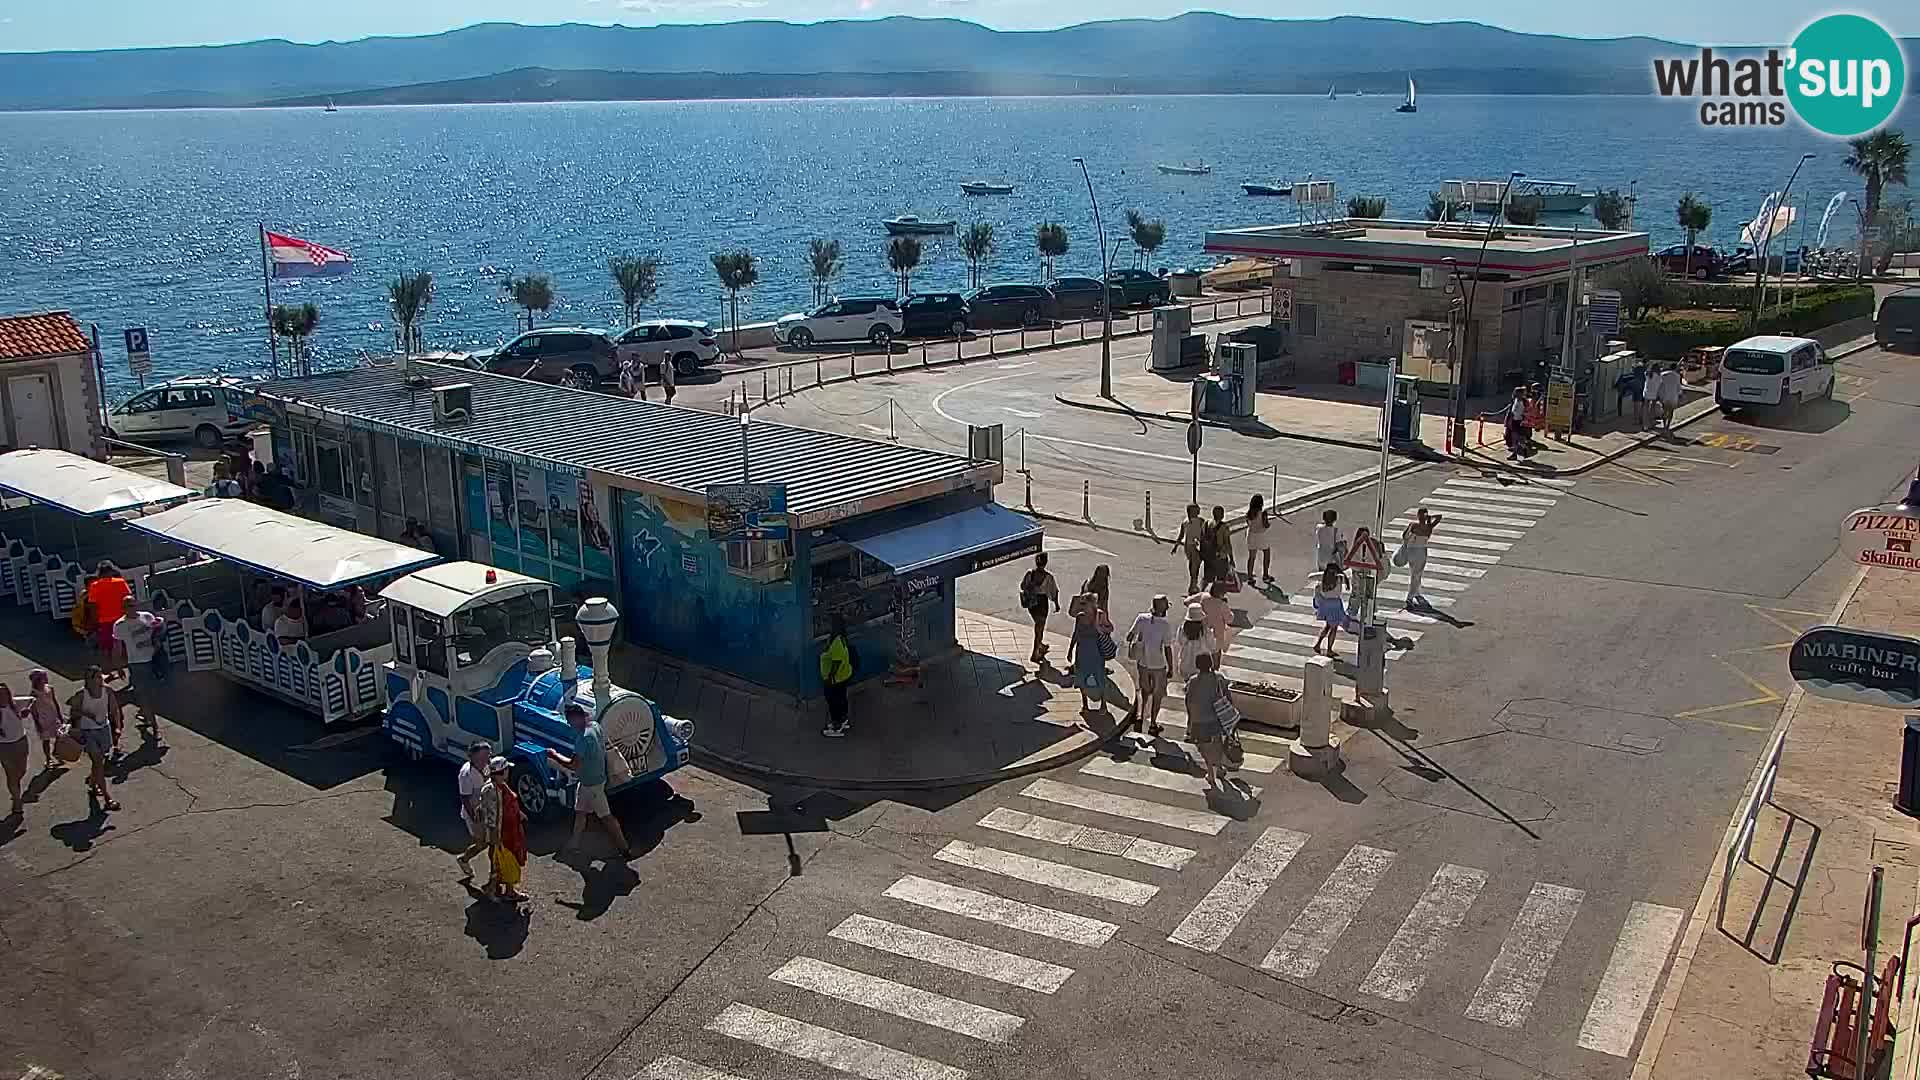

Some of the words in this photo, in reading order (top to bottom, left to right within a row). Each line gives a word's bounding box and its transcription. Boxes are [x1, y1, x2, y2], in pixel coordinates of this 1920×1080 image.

[130, 331, 143, 350] P
[478, 446, 493, 458] BUS
[494, 450, 526, 465] STATION
[528, 457, 553, 471] TICKET
[556, 463, 583, 477] OFFICE
[1849, 515, 1920, 533] PIZZE
[1802, 643, 1920, 673] MARINER
[1829, 662, 1867, 675] caffe
[1871, 665, 1899, 680] bar
